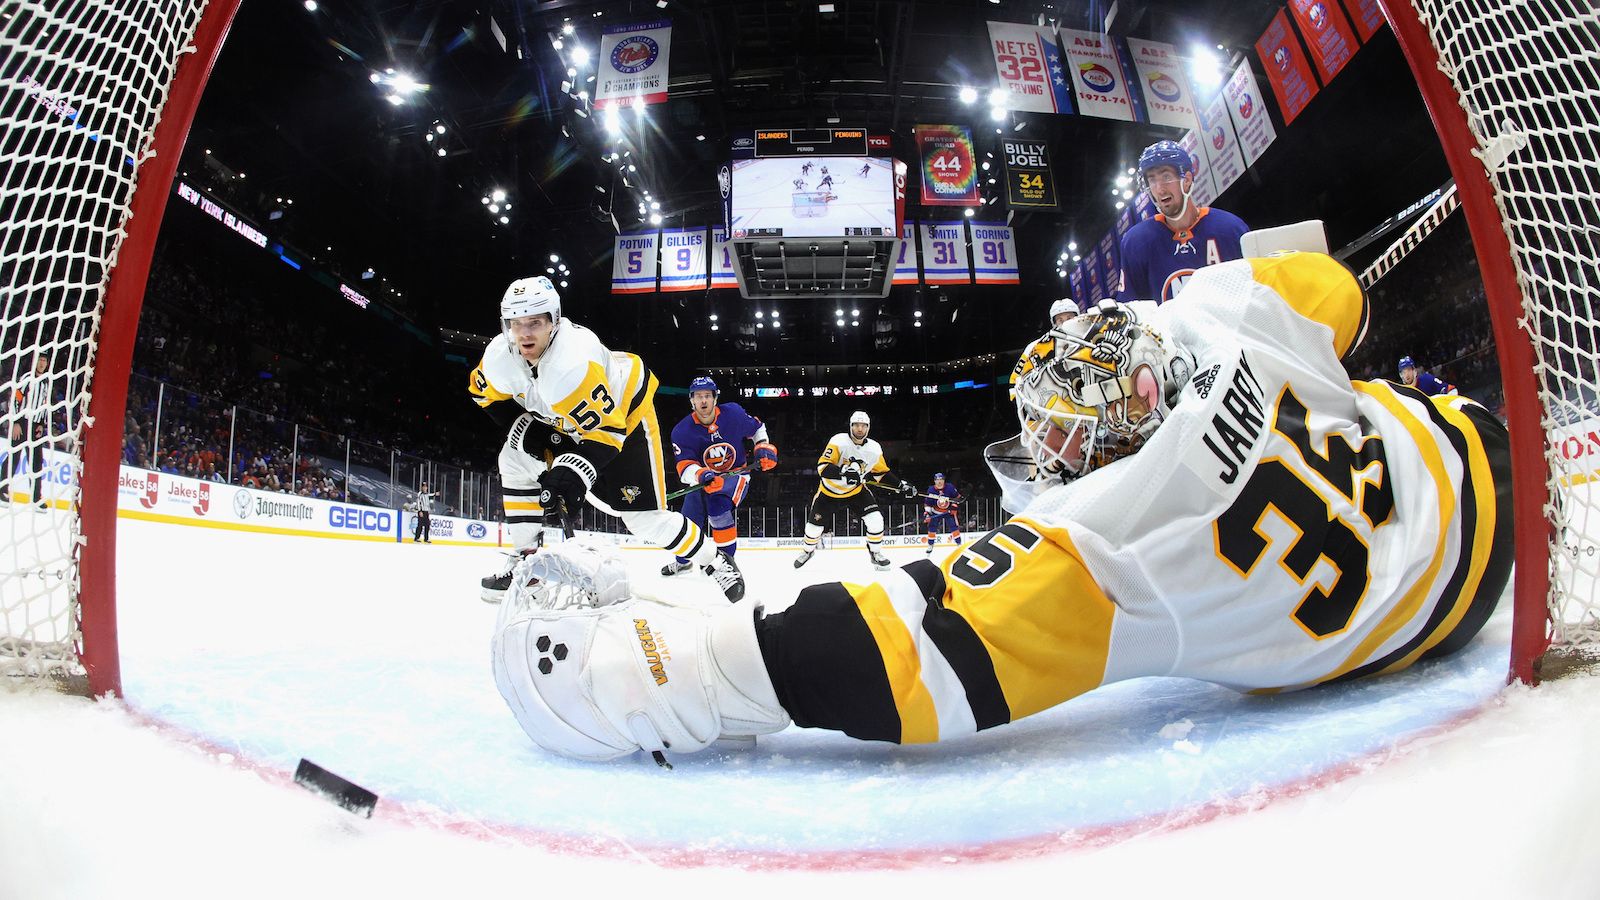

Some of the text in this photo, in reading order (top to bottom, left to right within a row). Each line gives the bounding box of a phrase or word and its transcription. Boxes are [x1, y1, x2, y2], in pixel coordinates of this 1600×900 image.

[995, 40, 1038, 56] NETS
[1073, 37, 1103, 48] ABA
[1067, 49, 1114, 60] CHAMPIONS
[1141, 46, 1169, 58] ABA
[633, 62, 649, 72] YORK
[998, 55, 1045, 82] 32
[1135, 58, 1179, 71] CHAMPIONS
[612, 79, 660, 92] CHAMPIONS
[1008, 82, 1044, 96] ERVING
[1079, 92, 1127, 105] 1973-74
[757, 131, 789, 140] ISLANDERS
[869, 138, 889, 146] TCL
[1004, 143, 1046, 156] BILLY
[933, 156, 962, 171] 44
[1007, 154, 1048, 167] JOEL
[1018, 173, 1045, 189] 34
[1397, 188, 1441, 221] BAUER
[178, 182, 269, 249] NEW YORK ISLANDERS
[666, 235, 703, 247] GILLIES
[928, 229, 958, 239] SMITH
[975, 229, 1010, 240] GORING
[619, 239, 653, 250] POTVIN
[676, 248, 691, 271] 9
[932, 241, 958, 265] 31
[982, 241, 1008, 265] 91
[1206, 239, 1221, 266] A
[627, 251, 643, 274] 5
[1200, 363, 1222, 400] adidas
[567, 383, 616, 432] 53
[146, 481, 158, 493] 58
[167, 481, 210, 501] Jake's 58
[1211, 380, 1396, 642] 35
[329, 505, 391, 532] GEICO
[776, 539, 805, 547] guaranteed
[903, 536, 942, 545] DISCOER
[951, 523, 1043, 588] 5
[632, 618, 669, 687] VAUGHN
[652, 631, 672, 662] JARRY
